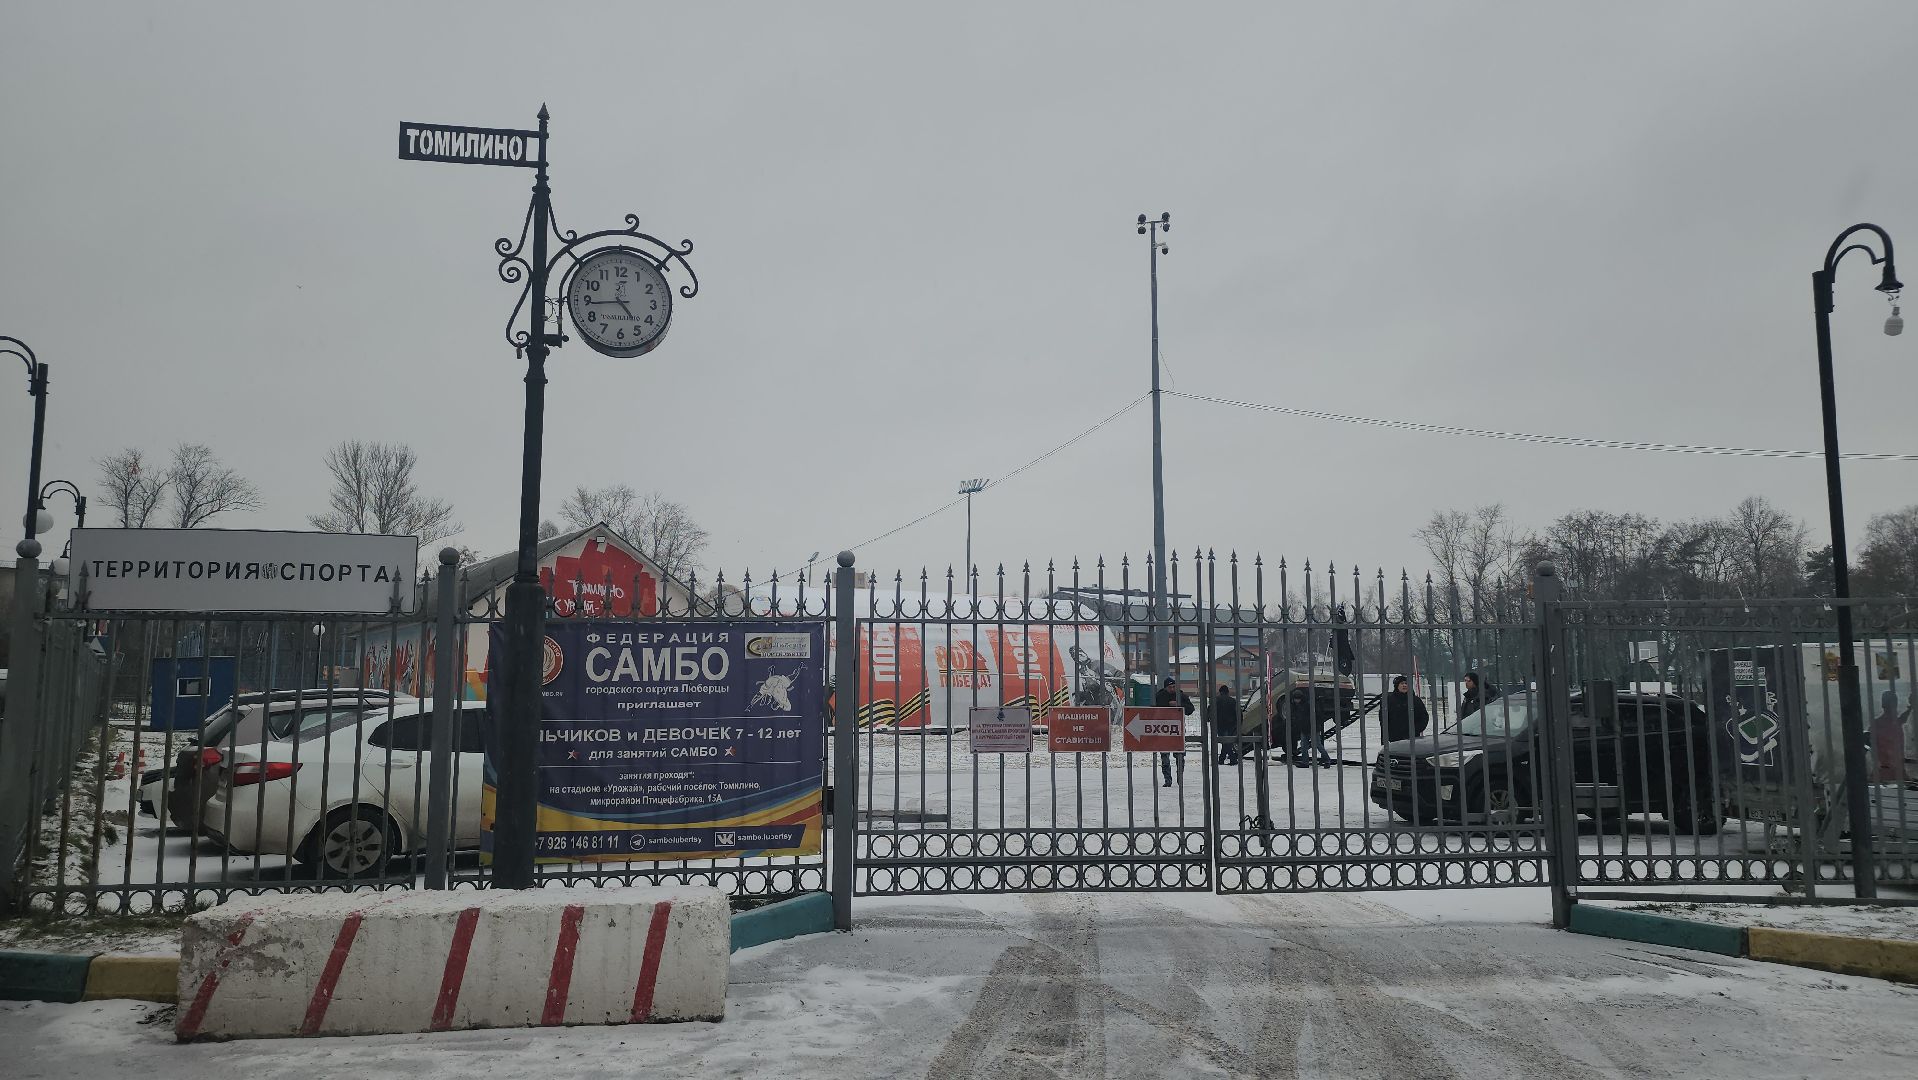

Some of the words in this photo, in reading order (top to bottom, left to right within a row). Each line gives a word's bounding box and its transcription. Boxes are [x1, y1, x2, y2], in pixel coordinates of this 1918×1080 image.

[406, 128, 523, 161] ТОМИЛИНО
[599, 269, 609, 281] 11
[614, 266, 628, 278] 12
[635, 271, 641, 282] 1
[585, 280, 600, 291] 10
[645, 283, 654, 295] 2
[583, 294, 592, 306] 9
[649, 299, 657, 311] 3
[587, 311, 597, 322] 8
[644, 314, 654, 326] 4
[600, 322, 609, 335] 7
[616, 328, 625, 339] 6
[633, 325, 642, 336] 5
[92, 559, 260, 580] ТЕРРИТОРИЯ
[280, 561, 390, 583] СПОРТА
[586, 632, 729, 645] ФЕДЕРАЦИЯ
[585, 646, 730, 682] САМБО
[585, 685, 643, 696] городского
[645, 684, 679, 695] округа
[680, 683, 729, 695] Люберцы
[617, 701, 701, 711] приглашает
[627, 731, 638, 741] и
[642, 726, 732, 743] ДЕВОЧЕК
[735, 728, 744, 739] 7
[757, 728, 773, 739] 12
[776, 729, 801, 739] лет
[1144, 724, 1180, 736] ВХОД
[1055, 736, 1102, 744] СТАВИТЬ!!!
[588, 750, 614, 760] для
[616, 747, 667, 759] занятий
[670, 746, 718, 757] САМБО
[619, 773, 652, 781] занятия
[549, 786, 560, 794] на
[561, 785, 600, 795] стадионе
[647, 782, 682, 794] рабочий
[683, 781, 718, 792] посёлок
[590, 797, 641, 807] микрорайон
[547, 836, 567, 850] 926
[570, 836, 589, 849] 146
[591, 835, 603, 849] 81
[607, 835, 619, 849] 11
